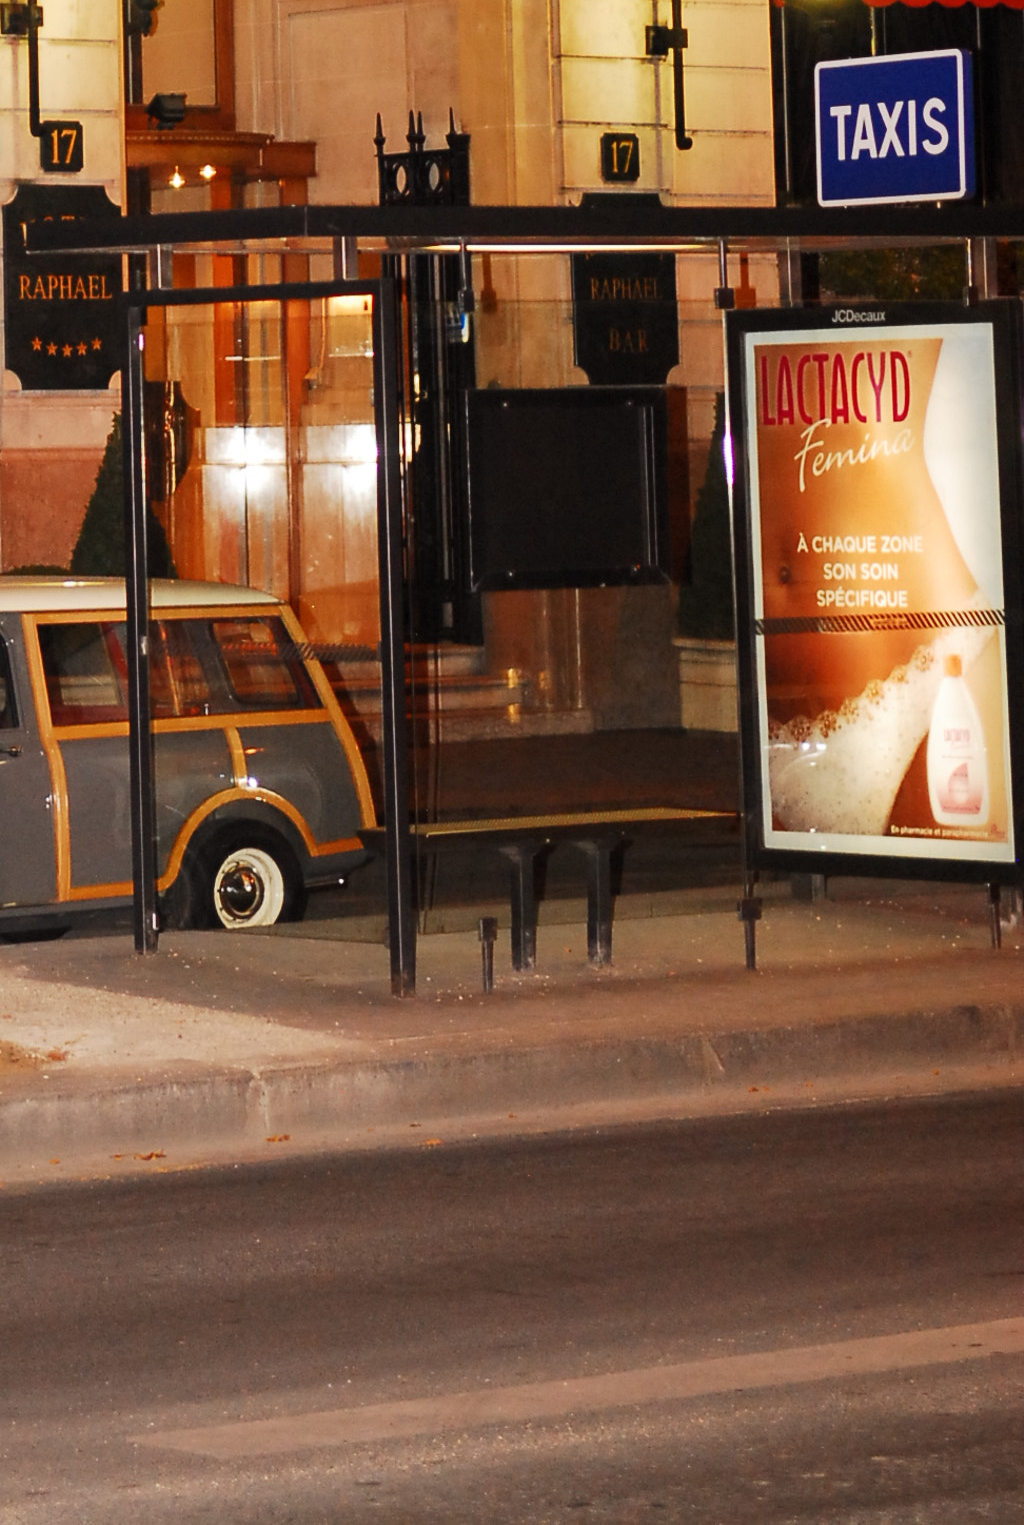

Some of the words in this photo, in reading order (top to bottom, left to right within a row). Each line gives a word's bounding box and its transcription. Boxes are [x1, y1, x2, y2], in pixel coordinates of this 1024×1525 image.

[829, 97, 949, 161] TAXIS
[50, 129, 77, 164] 17
[611, 141, 634, 173] 17
[19, 274, 113, 299] RAPHAEL
[590, 276, 662, 301] RAPHAEL
[831, 309, 886, 323] JCDecaux
[609, 328, 649, 353] BAR
[761, 351, 911, 425] LACTACYD
[794, 418, 914, 492] Femina
[796, 533, 808, 553] À
[812, 536, 876, 556] CHAQUE
[881, 535, 923, 553] ZONE
[823, 562, 856, 580] SON
[861, 562, 898, 580] SOIN
[816, 585, 908, 607] SPÉCIFIQUE
